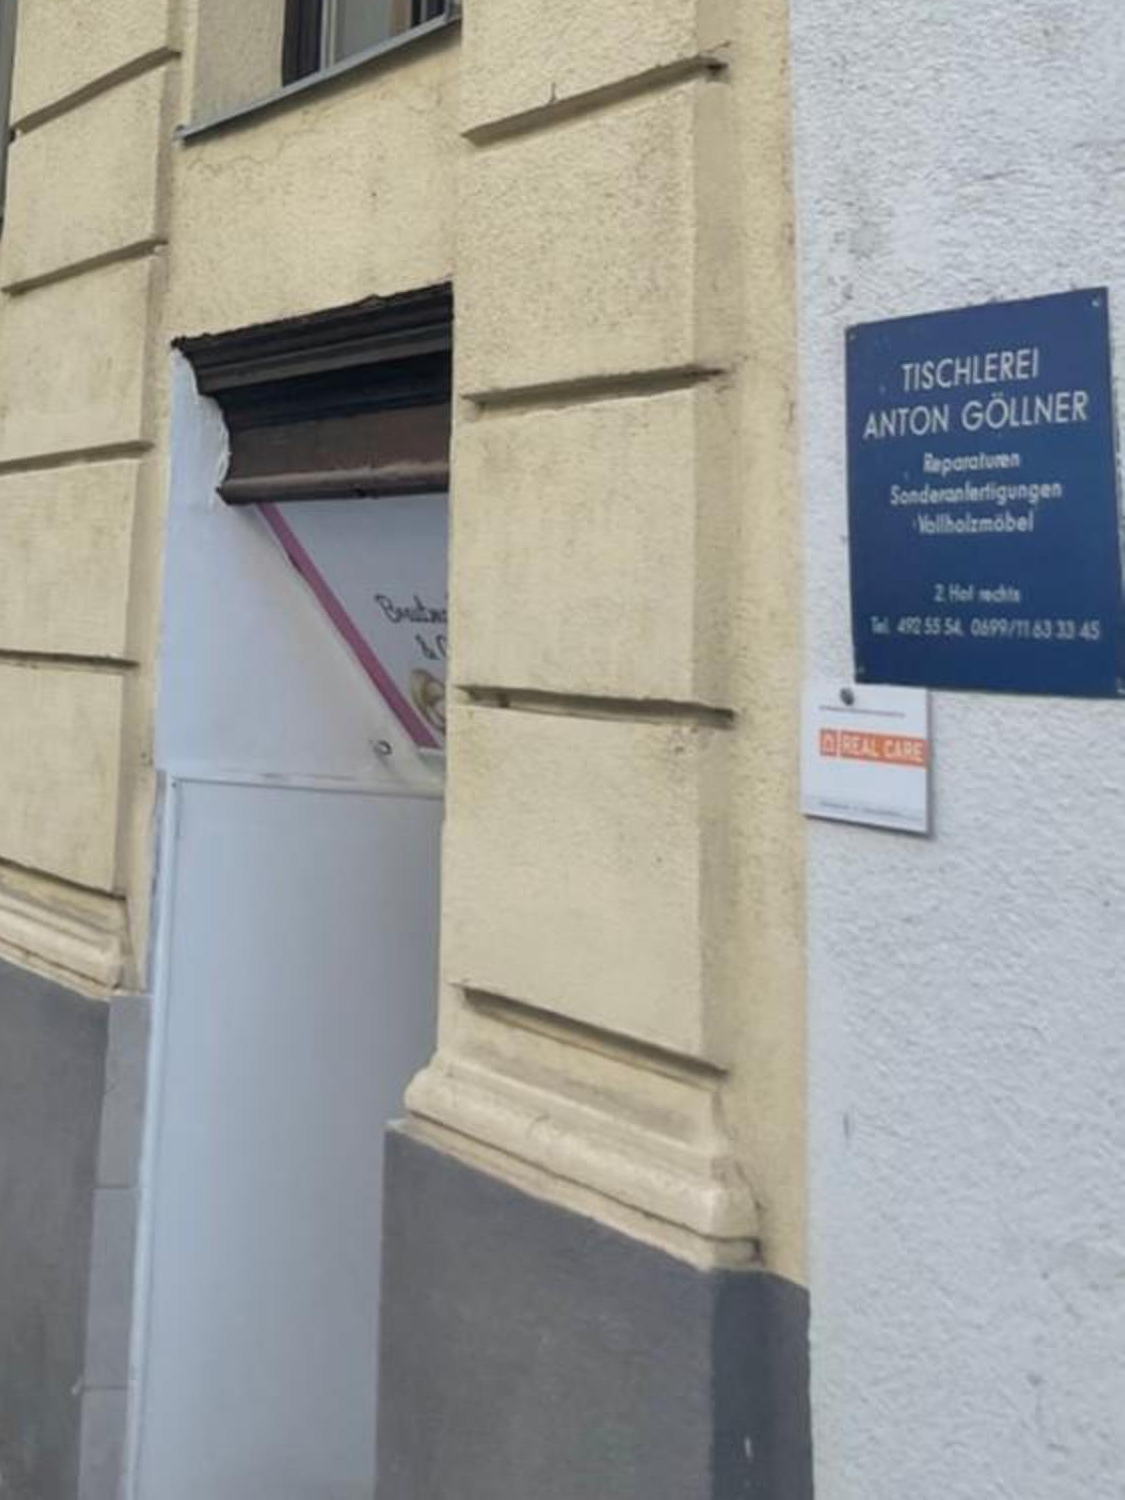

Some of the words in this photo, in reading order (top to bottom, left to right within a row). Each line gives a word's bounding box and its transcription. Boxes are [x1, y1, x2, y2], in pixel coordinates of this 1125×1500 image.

[903, 348, 1039, 392] TISCHLEREI
[864, 405, 950, 439] ANTON
[962, 391, 1088, 432] GÖLLNER
[923, 452, 1020, 475] Reparaturen
[891, 481, 1063, 506] Sonderanfertigungen
[917, 511, 1034, 535] Vollholzmöbel
[948, 584, 973, 601] Hof
[979, 585, 1020, 603] rechts
[842, 735, 878, 757] REAL
[883, 740, 924, 763] CARE
